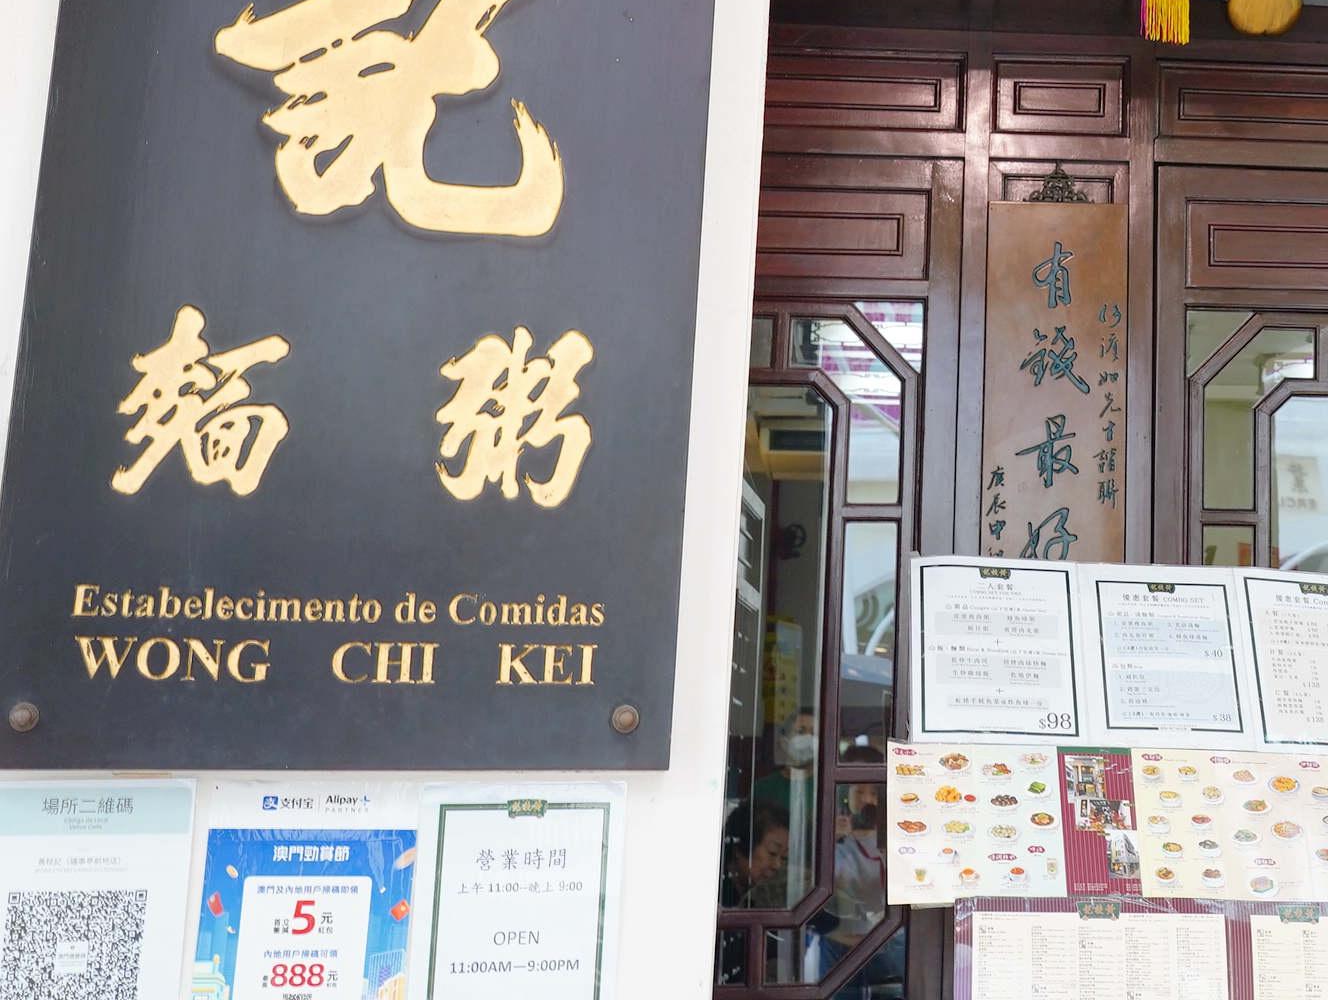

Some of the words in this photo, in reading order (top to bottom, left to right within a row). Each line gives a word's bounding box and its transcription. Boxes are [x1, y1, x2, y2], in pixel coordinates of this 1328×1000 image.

[72, 583, 382, 623] Estabelecimento
[394, 592, 437, 624] de
[449, 593, 605, 627] Comidas
[74, 635, 271, 684] WONG
[332, 640, 439, 684] CHI
[495, 643, 599, 685] KEI
[1038, 712, 1072, 729] $98
[42, 797, 135, 816] 場所二維碼
[273, 845, 351, 862] 澳門勁賞節
[476, 849, 567, 871] 營業時間
[458, 881, 484, 894] 上午
[559, 880, 583, 892] 9:00
[292, 900, 315, 935] 5
[321, 912, 333, 924] 元
[493, 931, 540, 946] OPEN
[270, 964, 324, 987] 888
[328, 970, 338, 982] 元
